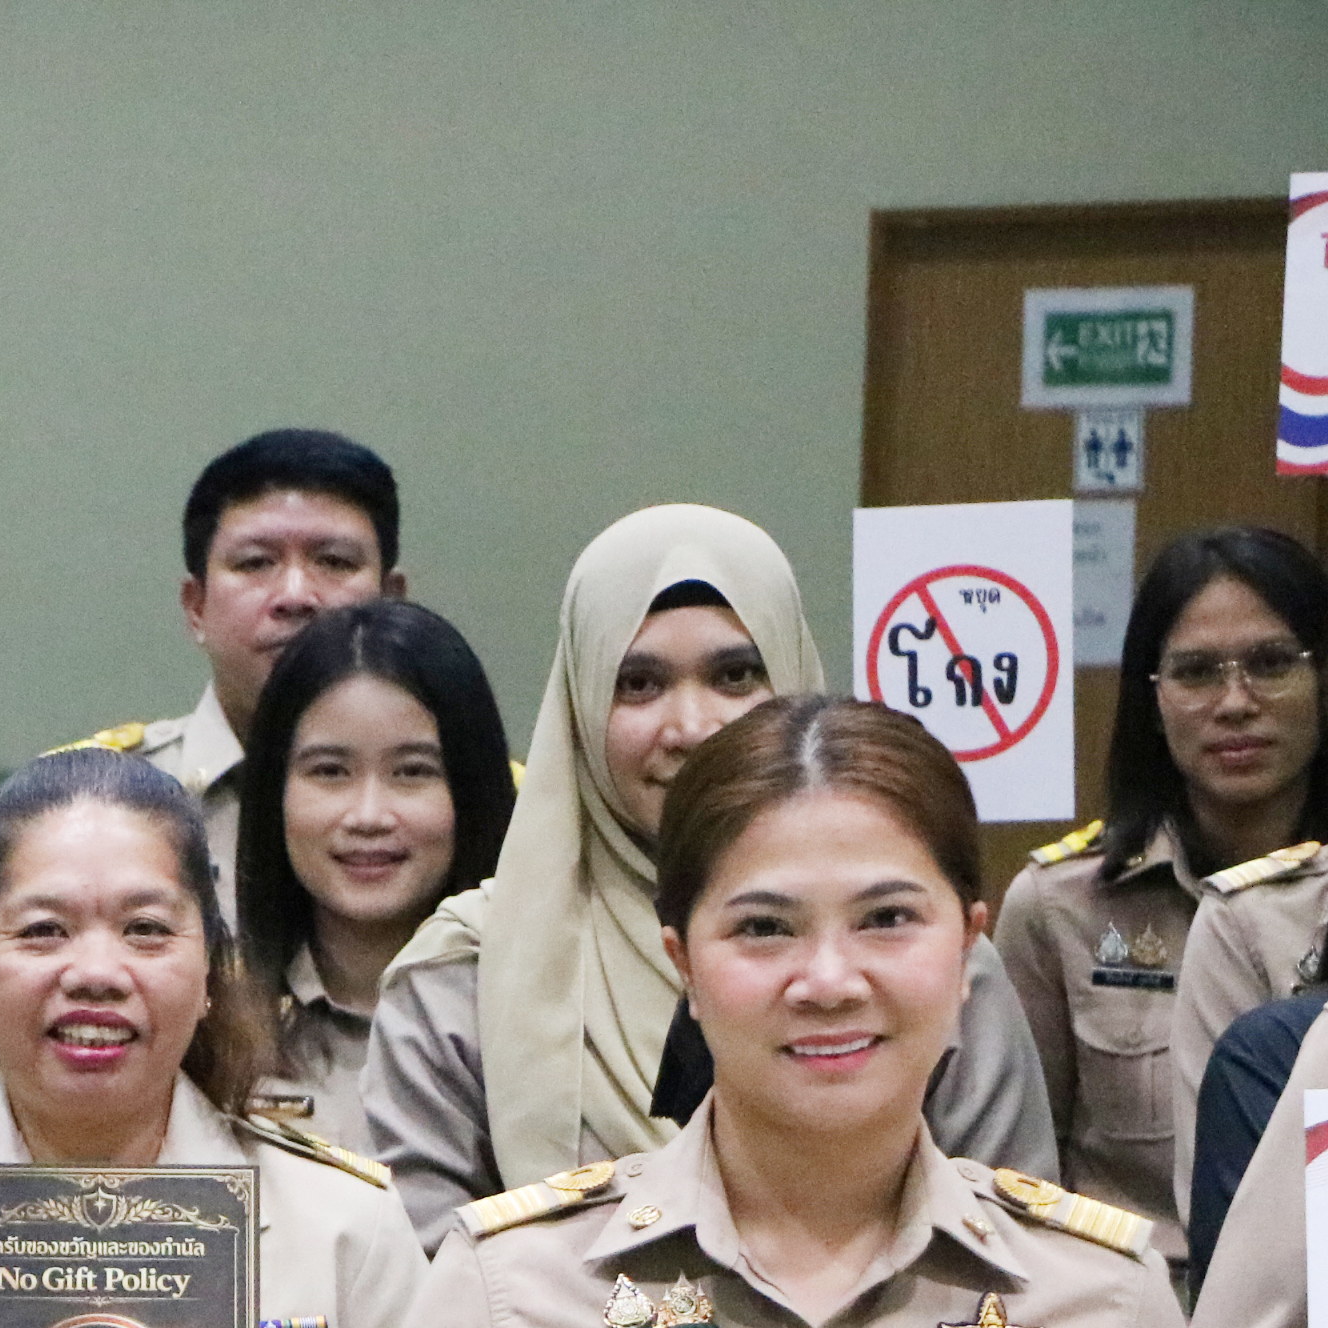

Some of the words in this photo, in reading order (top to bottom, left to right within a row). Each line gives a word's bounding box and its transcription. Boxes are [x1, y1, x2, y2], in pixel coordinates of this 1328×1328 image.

[958, 587, 1002, 613] หยุด
[887, 615, 1019, 707] โกง
[42, 1267, 97, 1292] Gift
[103, 1268, 192, 1298] Policy
